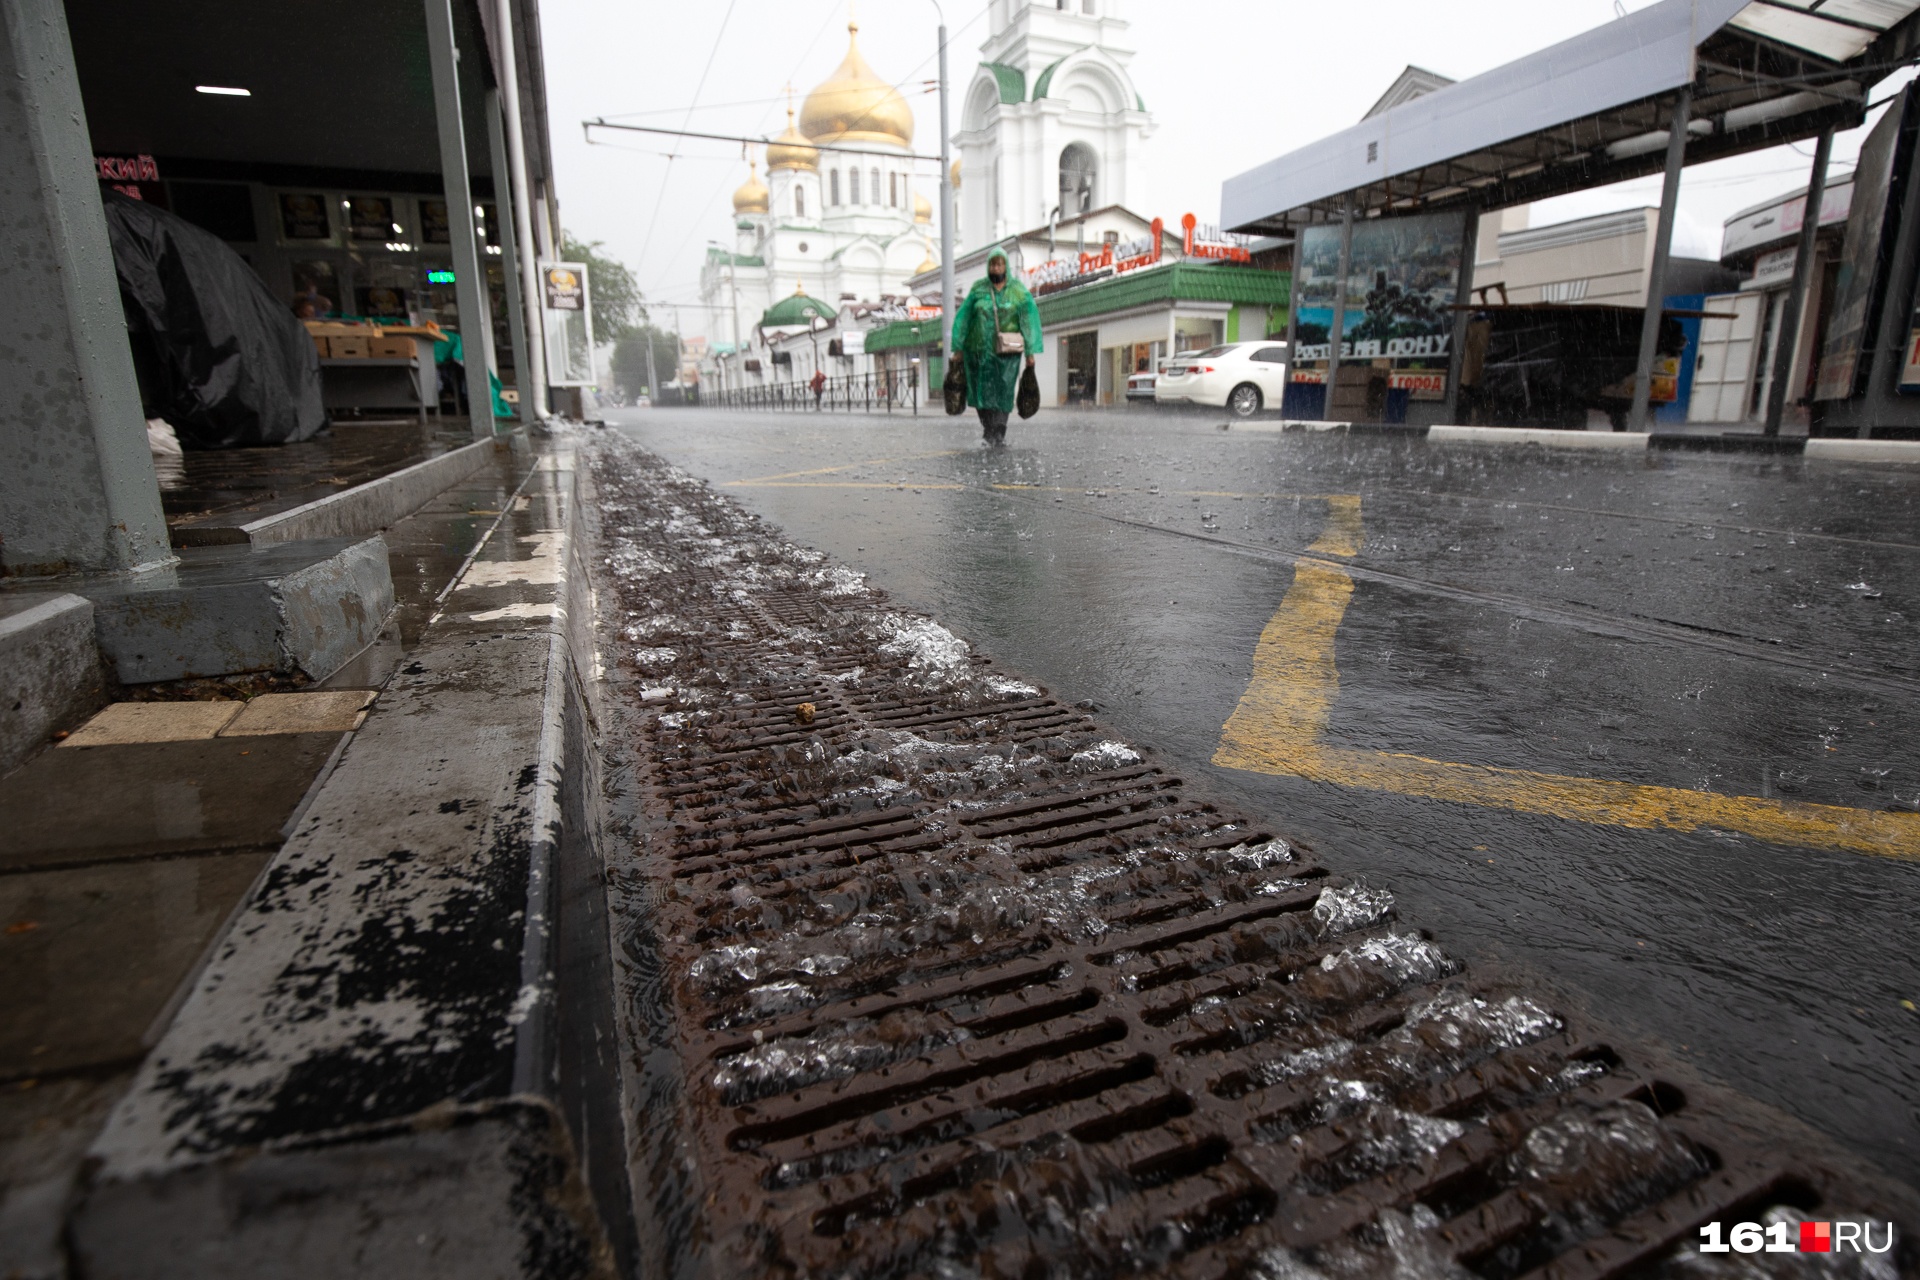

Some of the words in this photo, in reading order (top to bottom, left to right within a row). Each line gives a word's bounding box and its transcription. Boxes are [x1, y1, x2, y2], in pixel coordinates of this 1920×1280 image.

[1294, 341, 1352, 359] РОСТВ
[1353, 338, 1382, 356] НА
[1386, 333, 1451, 356] ДОНУ
[1397, 375, 1442, 394] город
